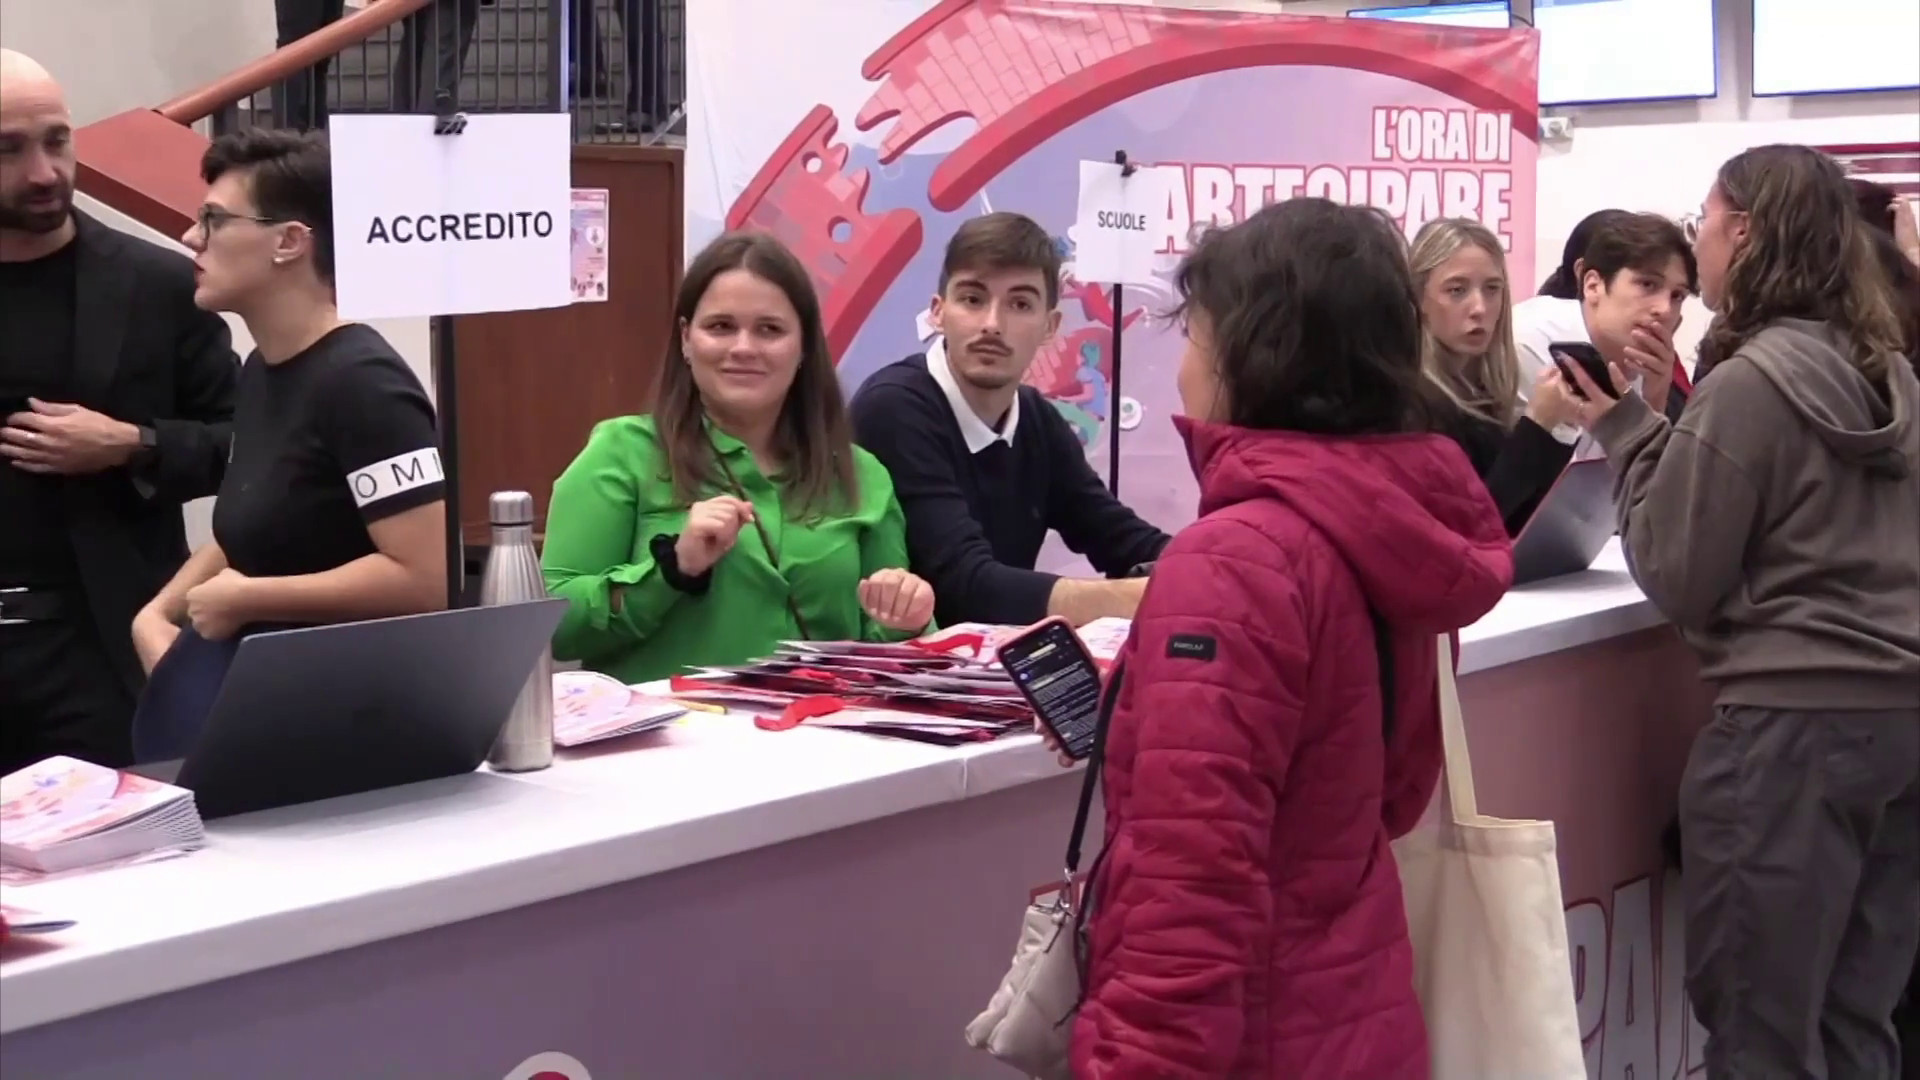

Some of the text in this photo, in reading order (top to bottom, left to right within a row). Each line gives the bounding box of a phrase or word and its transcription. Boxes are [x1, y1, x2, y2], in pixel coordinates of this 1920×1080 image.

[1373, 106, 1513, 165] L'ORA DI
[366, 210, 554, 244] ACCREDITO
[1097, 210, 1147, 232] SCUOLE
